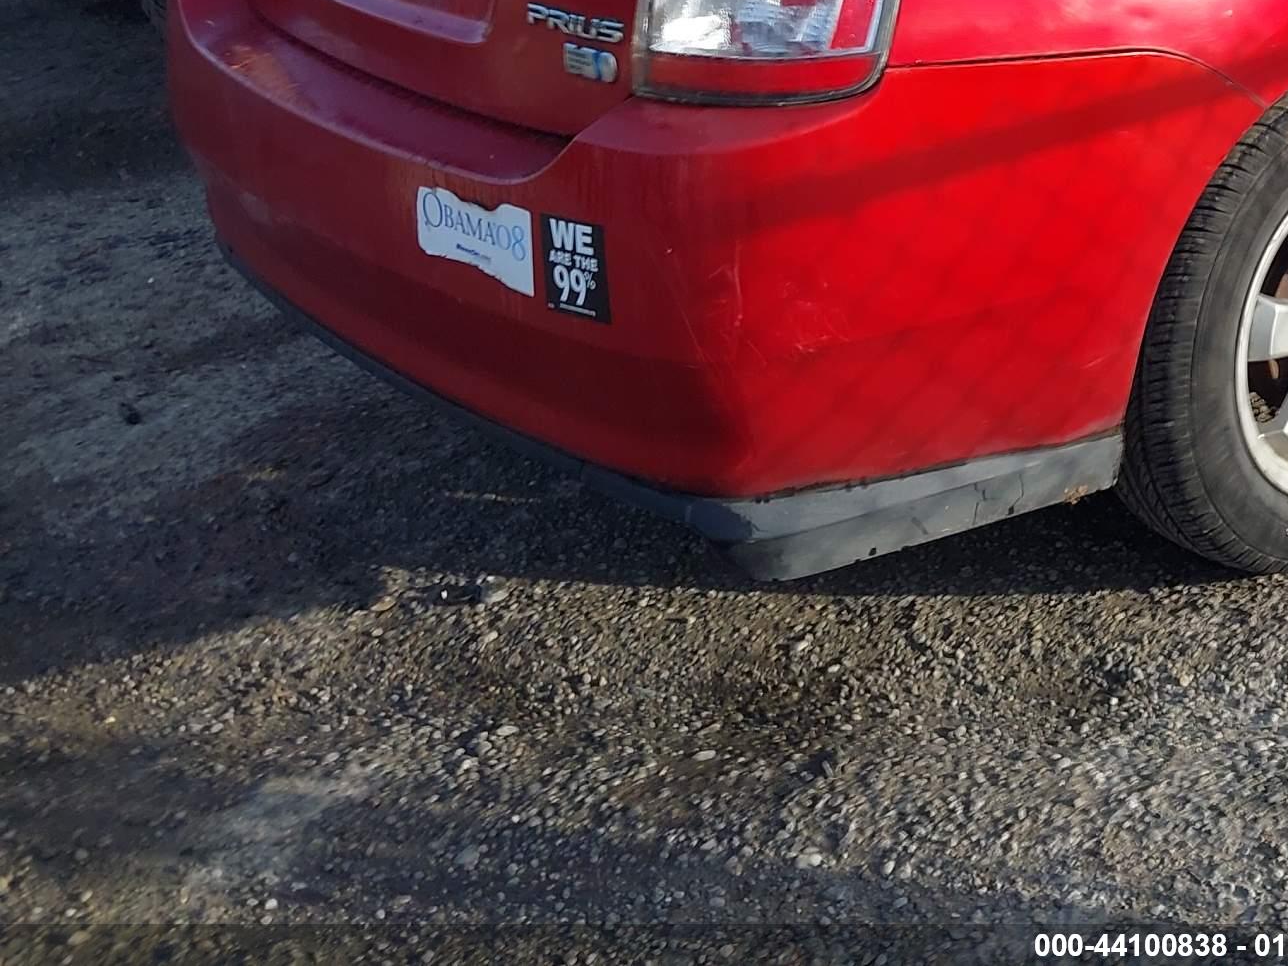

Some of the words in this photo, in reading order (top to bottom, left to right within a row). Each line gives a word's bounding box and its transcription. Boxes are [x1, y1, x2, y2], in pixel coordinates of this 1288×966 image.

[527, 2, 624, 43] PRIUS
[549, 218, 593, 256] WE
[549, 250, 572, 267] ARE
[573, 254, 598, 272] THE
[553, 266, 596, 306] 99%
